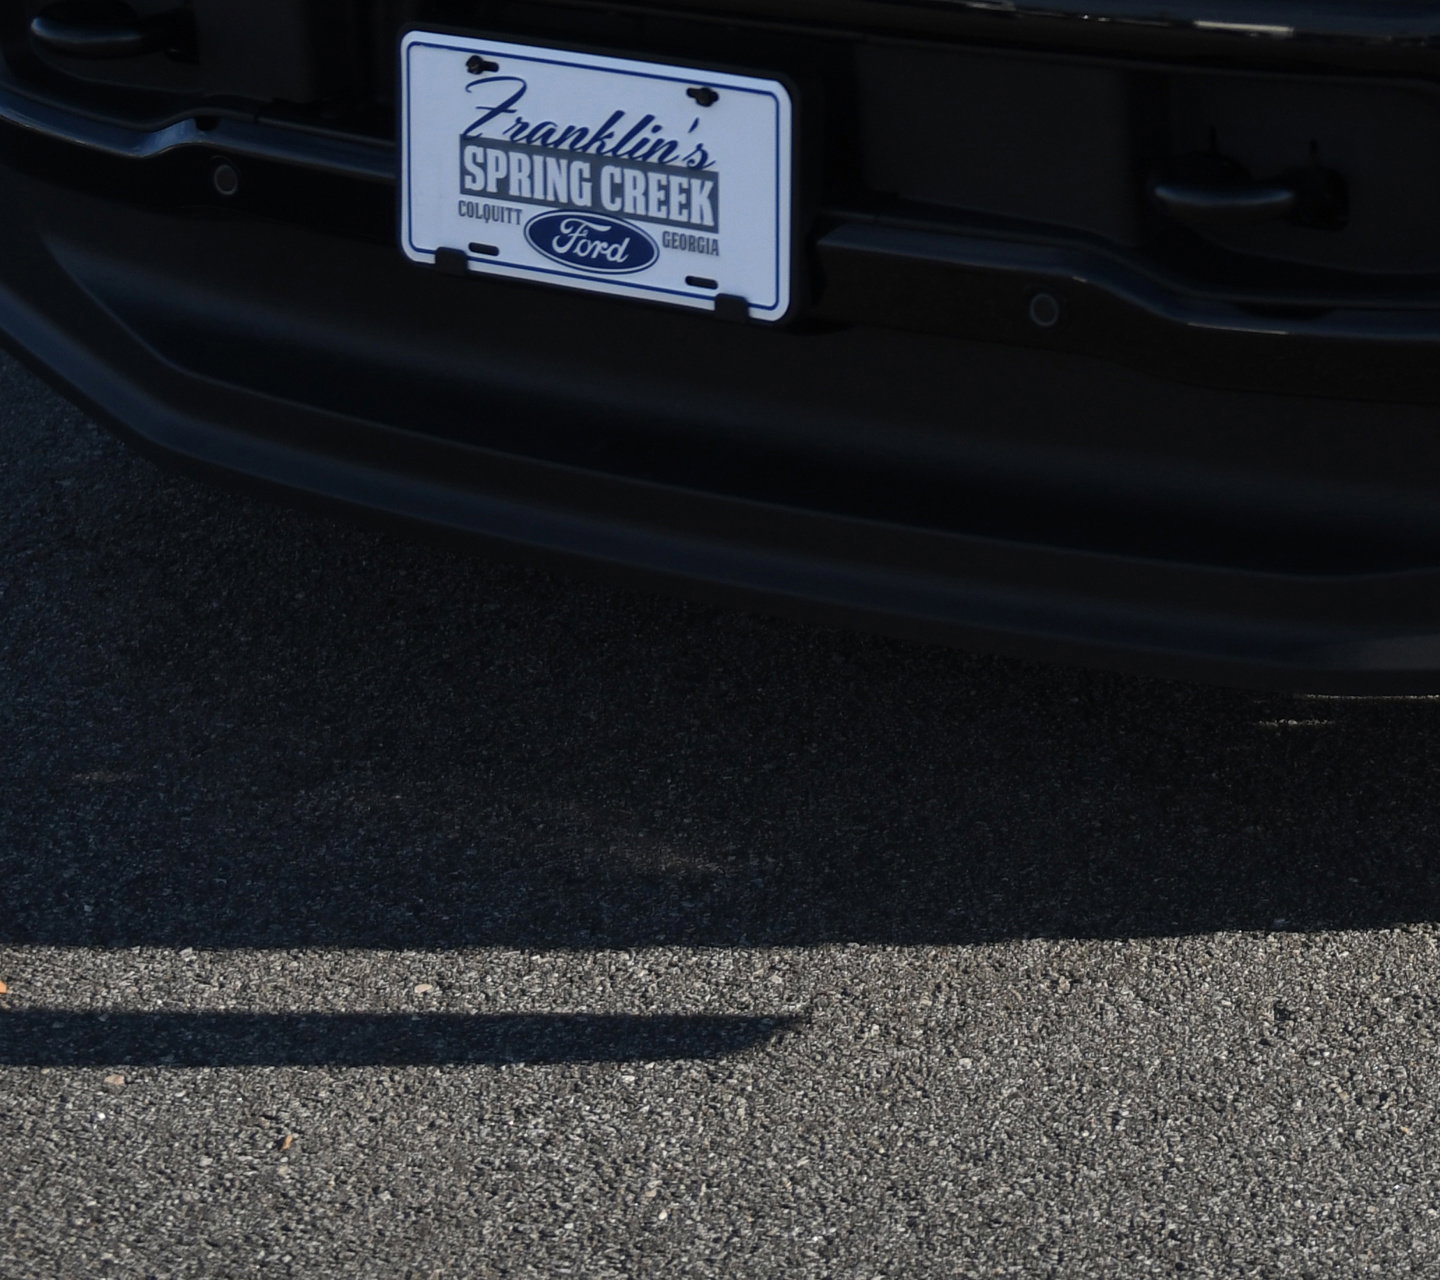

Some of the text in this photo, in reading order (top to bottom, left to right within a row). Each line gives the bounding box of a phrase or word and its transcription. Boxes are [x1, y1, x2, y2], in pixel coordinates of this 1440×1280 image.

[463, 74, 717, 171] Franklin's
[463, 144, 716, 228] SPRING CREEK
[457, 199, 524, 227] COLQUITT
[551, 217, 631, 265] Ford
[661, 230, 720, 257] GEORGIA
